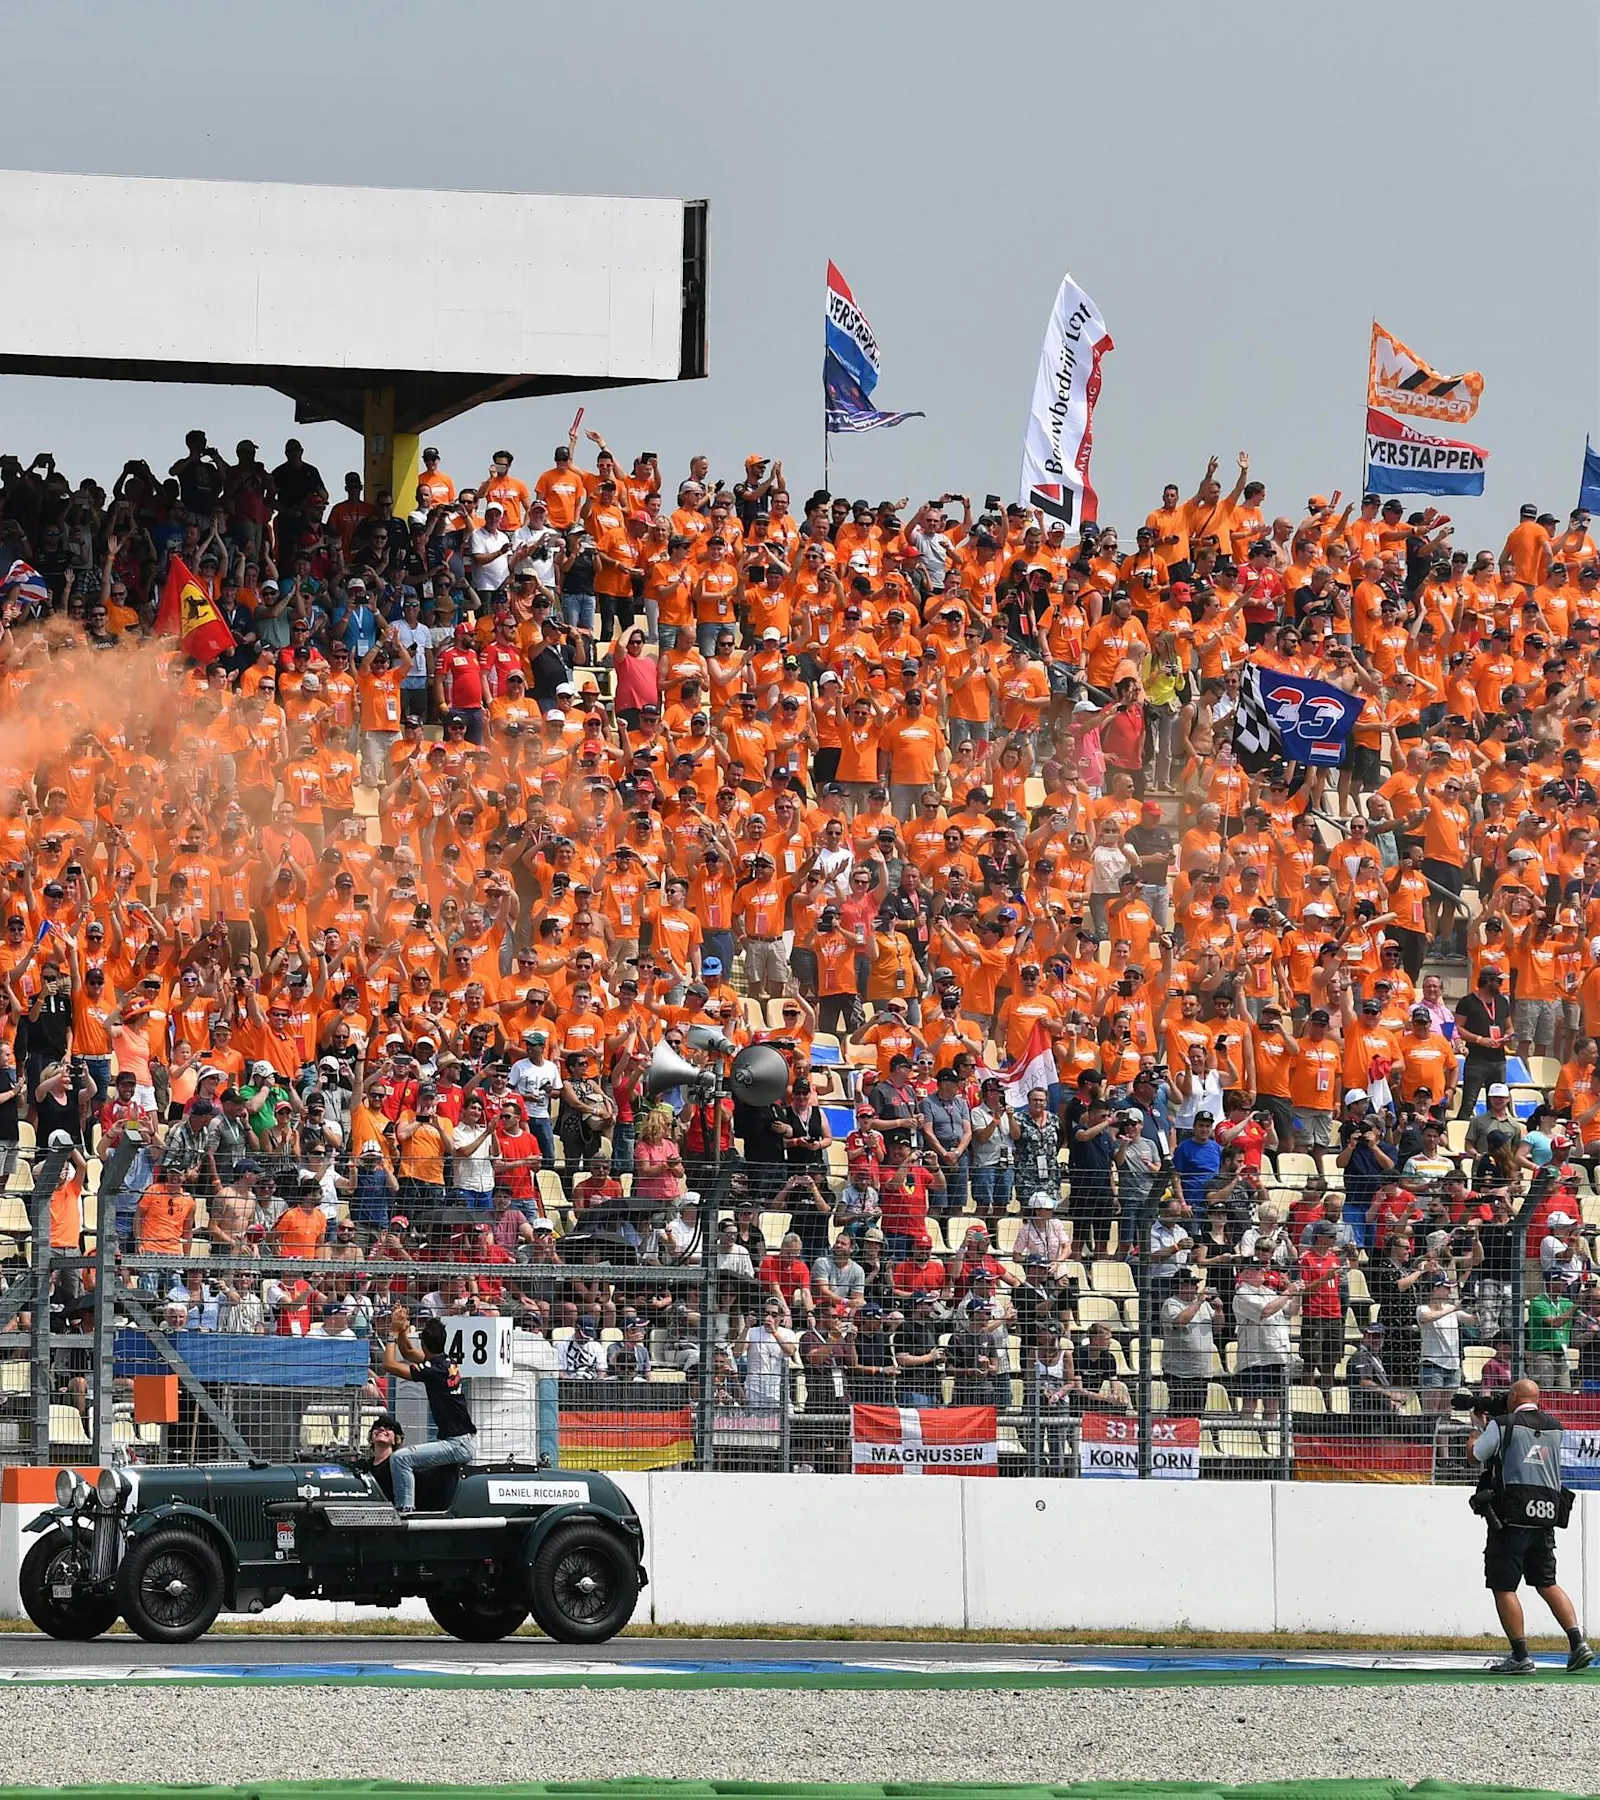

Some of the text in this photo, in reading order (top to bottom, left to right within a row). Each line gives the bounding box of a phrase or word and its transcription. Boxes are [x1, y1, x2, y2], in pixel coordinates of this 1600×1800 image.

[1045, 341, 1077, 474] Bouwbedrijf
[1368, 438, 1484, 470] VERSTAPPEN
[1266, 686, 1345, 739] 33
[449, 1329, 488, 1365] 48
[500, 1329, 511, 1365] 48
[1105, 1420, 1128, 1438] 33
[871, 1447, 984, 1462] MAGNUSSEN
[1090, 1449, 1192, 1468] KORNORN
[499, 1487, 581, 1499] DANIEL RICCIARDO
[1525, 1499, 1555, 1519] 688
